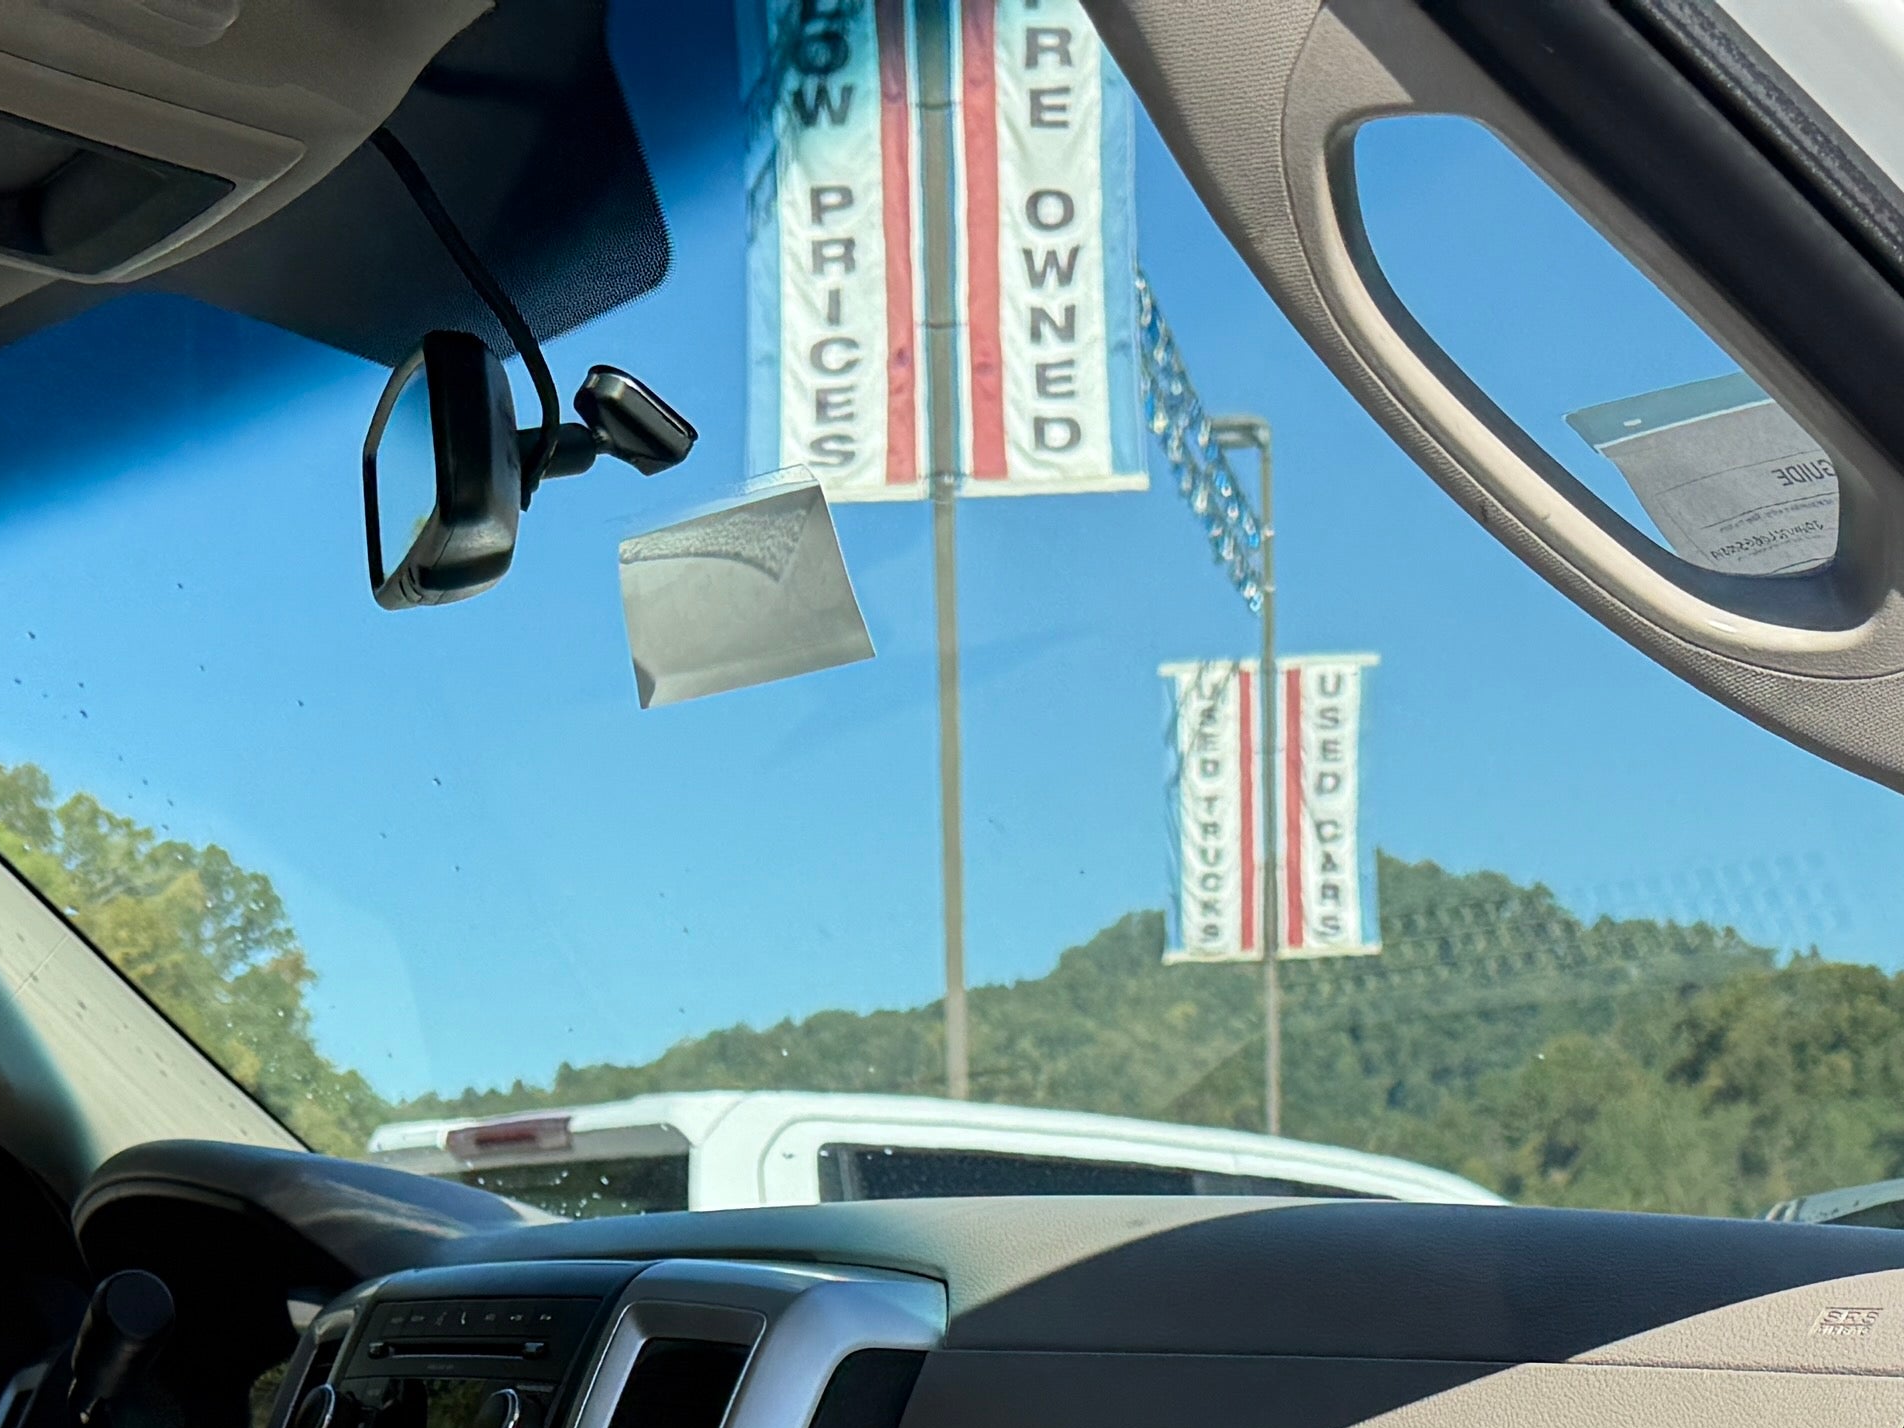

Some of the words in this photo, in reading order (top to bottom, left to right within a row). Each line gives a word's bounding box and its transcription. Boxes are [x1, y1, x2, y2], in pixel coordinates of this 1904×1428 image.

[1023, 0, 1073, 128] RE
[809, 187, 861, 468] PRICES
[1022, 189, 1082, 454] OWNED
[1317, 673, 1343, 796] USED
[1315, 819, 1343, 936] CARS
[1823, 1310, 1880, 1324] SRS
